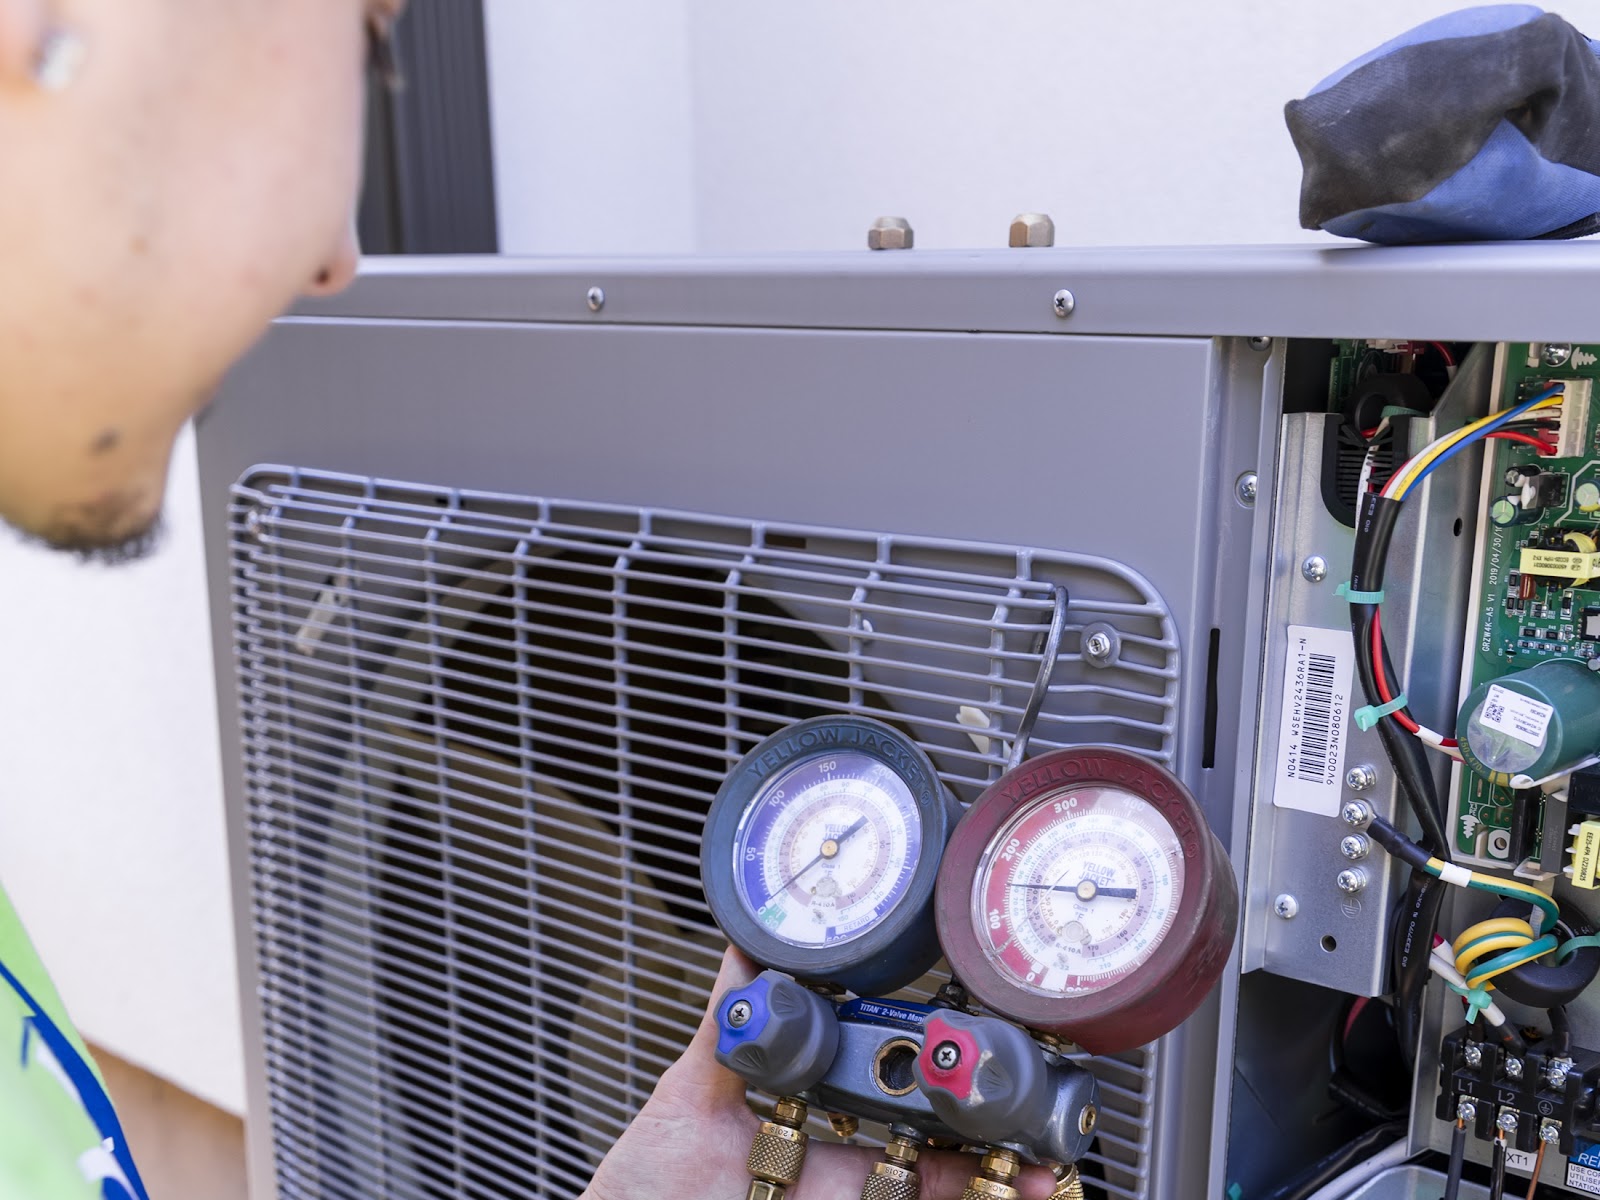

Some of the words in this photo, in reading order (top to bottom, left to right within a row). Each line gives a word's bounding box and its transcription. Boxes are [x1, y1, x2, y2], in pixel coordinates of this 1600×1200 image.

[1487, 593, 1496, 602] V1
[1482, 606, 1494, 652] GRZW4K-A5
[1291, 637, 1307, 737] WSEHV2436RA1-N
[1326, 693, 1344, 786] 9V0023N080612
[747, 727, 840, 778] YELLOW
[818, 760, 837, 774] 150
[871, 763, 893, 780] 200
[1001, 758, 1108, 803] YELLOW
[768, 789, 785, 808] 100
[1053, 797, 1078, 814] 300
[1122, 796, 1146, 812] 400
[745, 846, 757, 862] 50
[1000, 838, 1020, 862] 200
[1083, 860, 1117, 878] YELLOW
[757, 906, 767, 916] 0
[988, 908, 1002, 930] 100
[843, 915, 870, 932] RETARD
[1025, 971, 1036, 982] 0
[881, 1007, 907, 1020] 2-Valve
[907, 1012, 927, 1024] Mani
[1457, 1079, 1474, 1094] L1
[1497, 1089, 1516, 1105] L2
[1506, 1151, 1529, 1167] XT1
[1577, 1152, 1600, 1168] RE
[1570, 1164, 1586, 1175] USE
